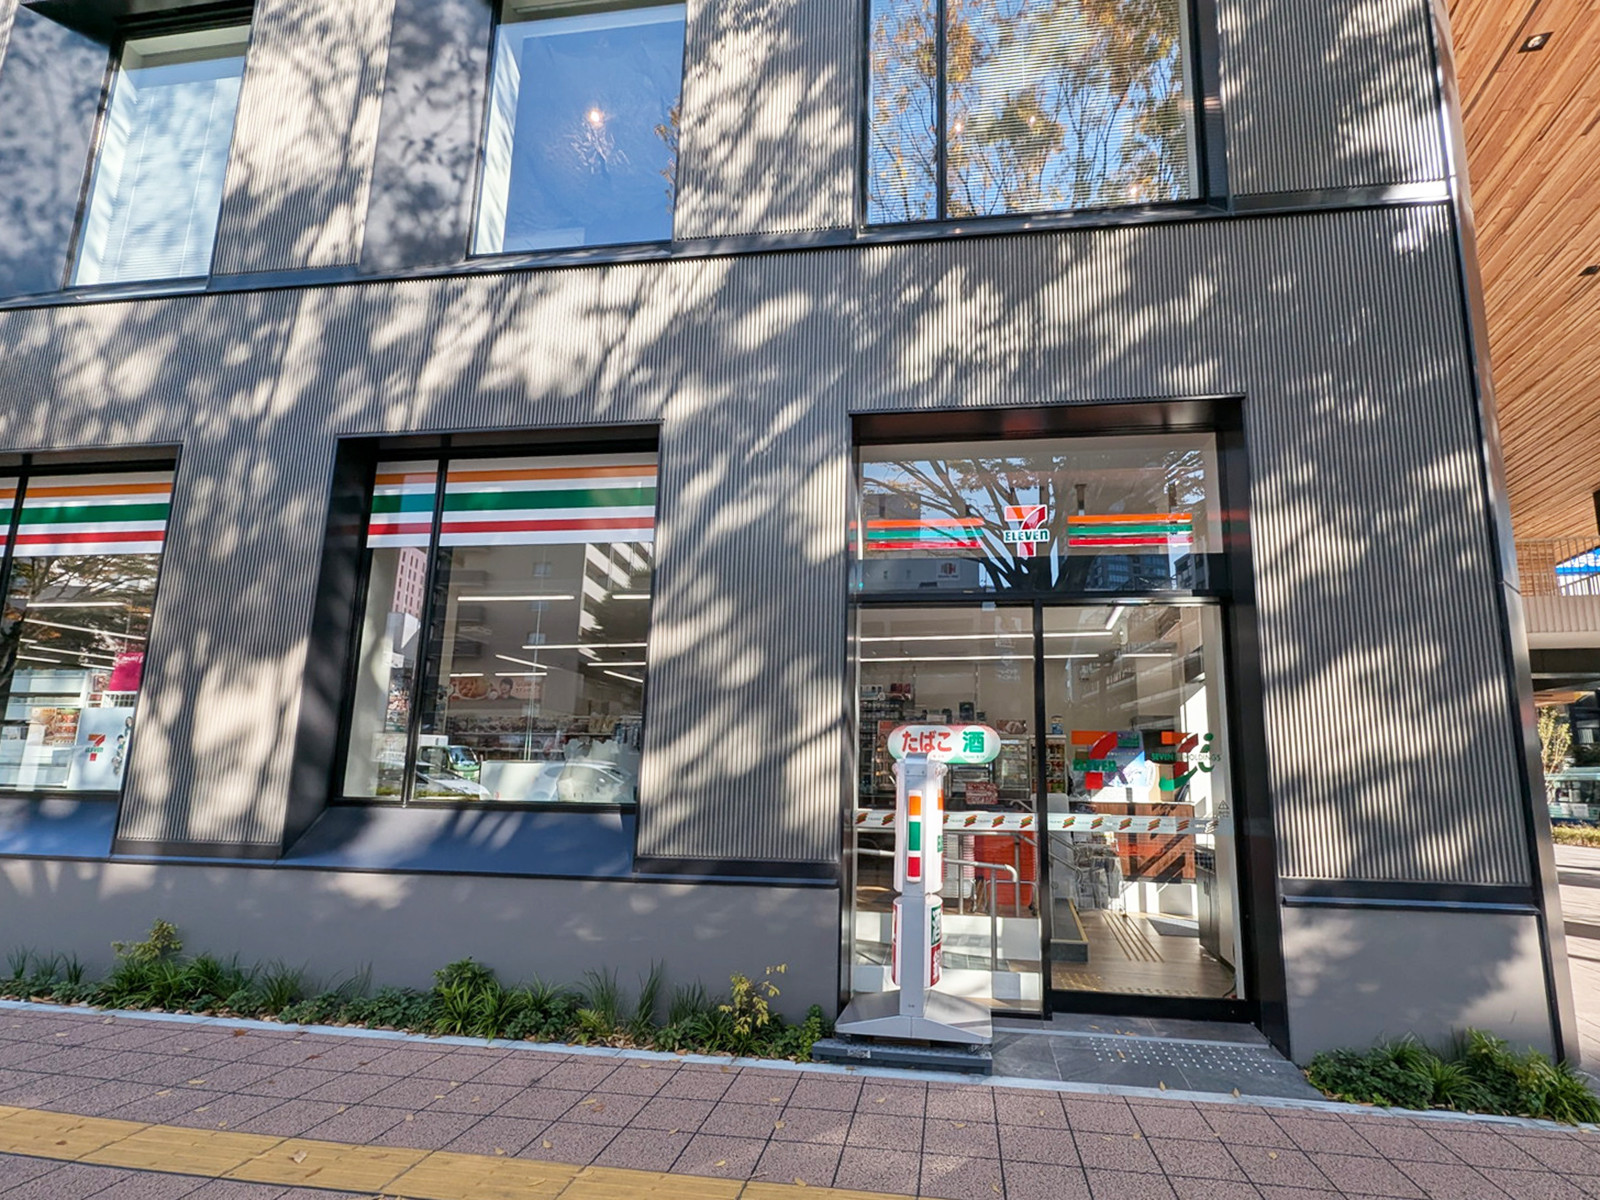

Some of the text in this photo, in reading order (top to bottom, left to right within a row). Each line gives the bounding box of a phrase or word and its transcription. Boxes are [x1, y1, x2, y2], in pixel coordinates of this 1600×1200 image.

[902, 731, 985, 753] たばこ 酒
